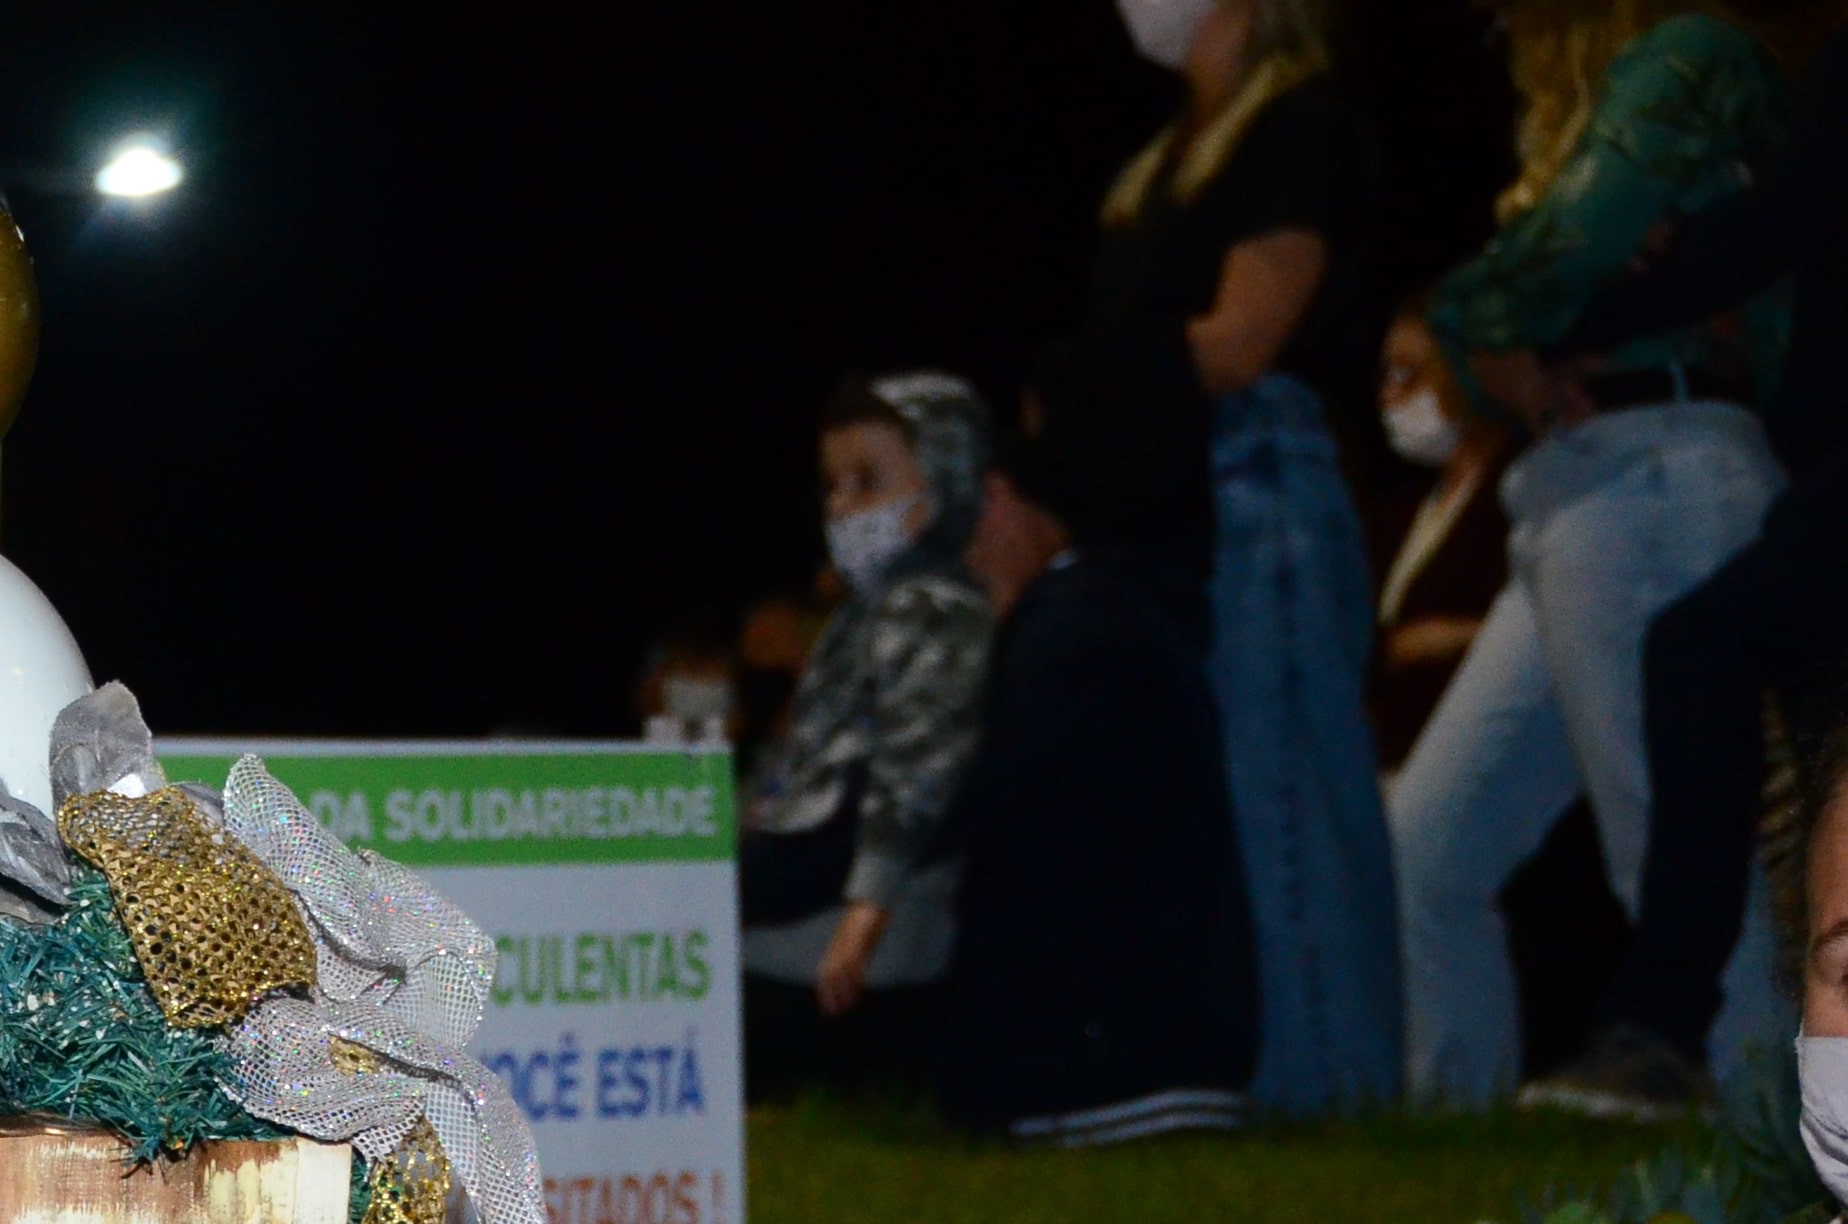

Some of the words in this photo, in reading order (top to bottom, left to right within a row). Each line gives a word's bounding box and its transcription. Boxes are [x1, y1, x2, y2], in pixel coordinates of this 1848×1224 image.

[384, 786, 717, 841] SOLIDARIEDADE
[491, 929, 709, 1005] CULENTAS
[481, 1031, 579, 1120] OCÊ
[596, 1026, 704, 1118] ESTÁ
